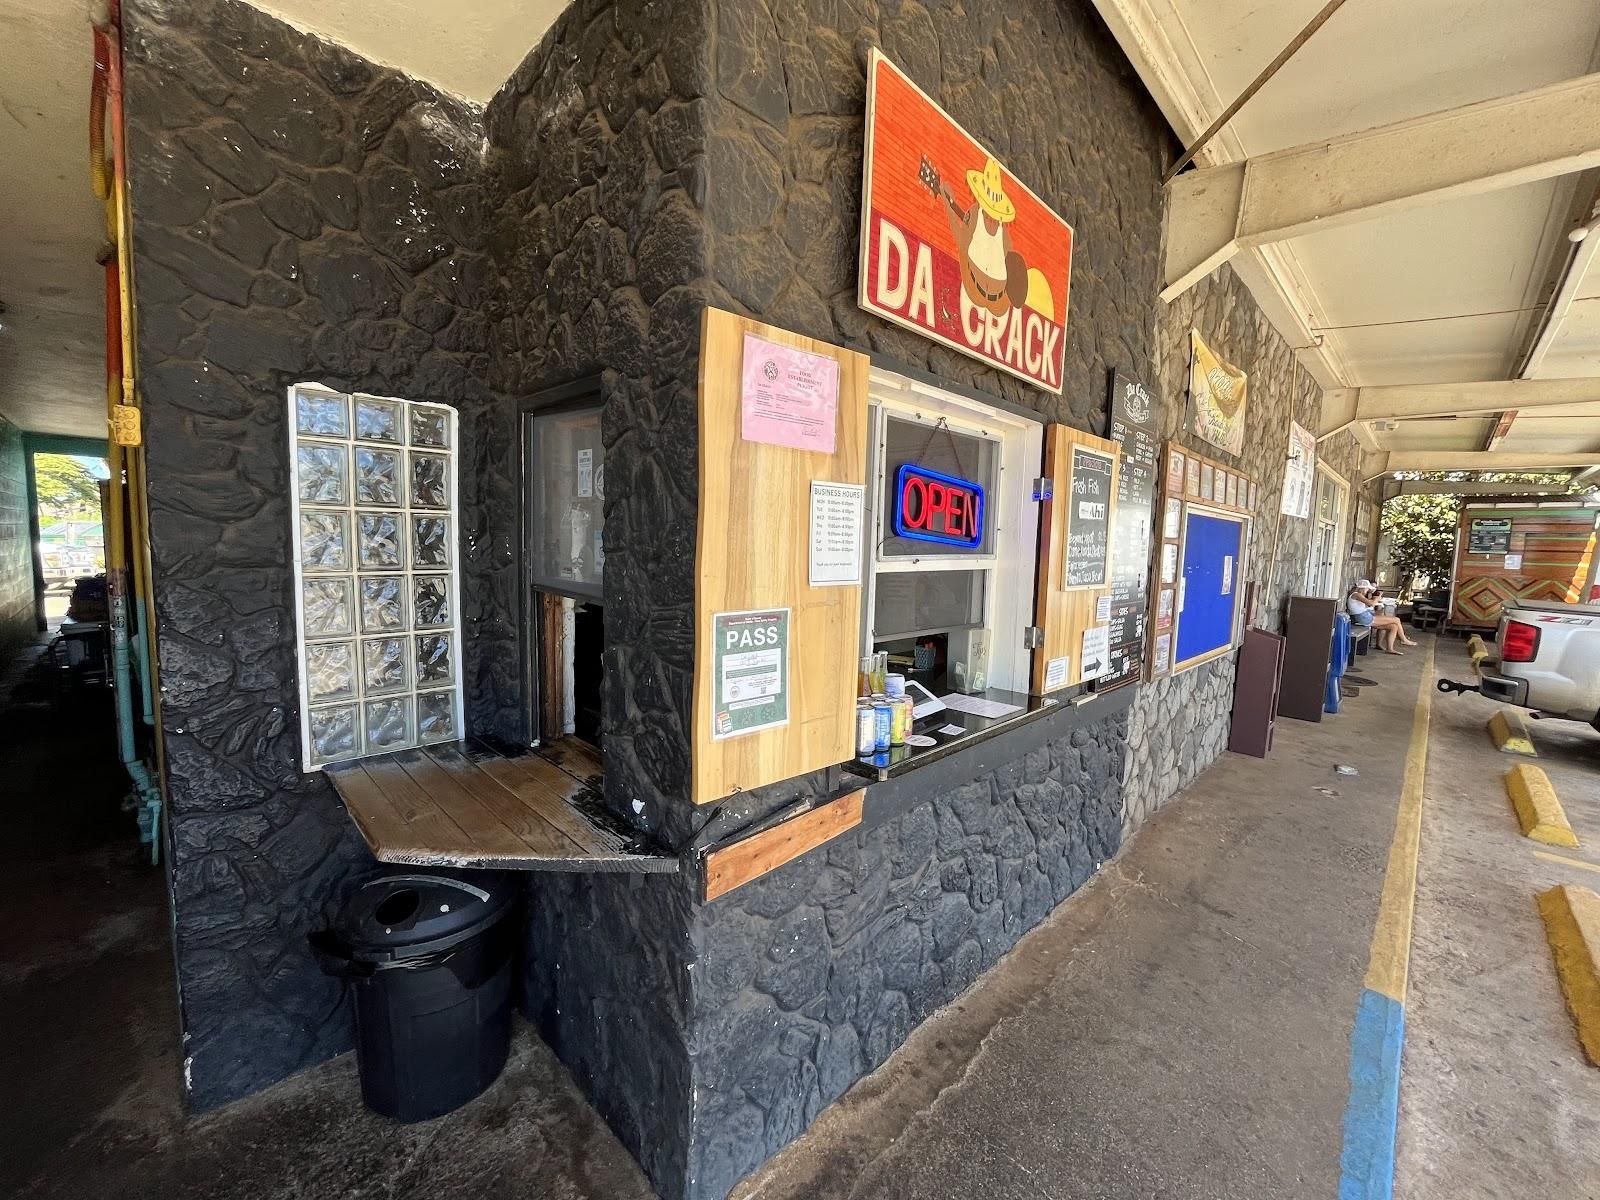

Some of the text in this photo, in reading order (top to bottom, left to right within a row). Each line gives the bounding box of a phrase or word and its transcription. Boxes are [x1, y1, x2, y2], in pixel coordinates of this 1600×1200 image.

[877, 218, 1060, 386] DA CRACK
[815, 487, 860, 499] BUSINESS HOURS
[1072, 476, 1100, 496] Fresh Fish
[903, 477, 980, 537] OPEN
[1089, 503, 1104, 519] Ahi
[726, 626, 778, 650] PASS
